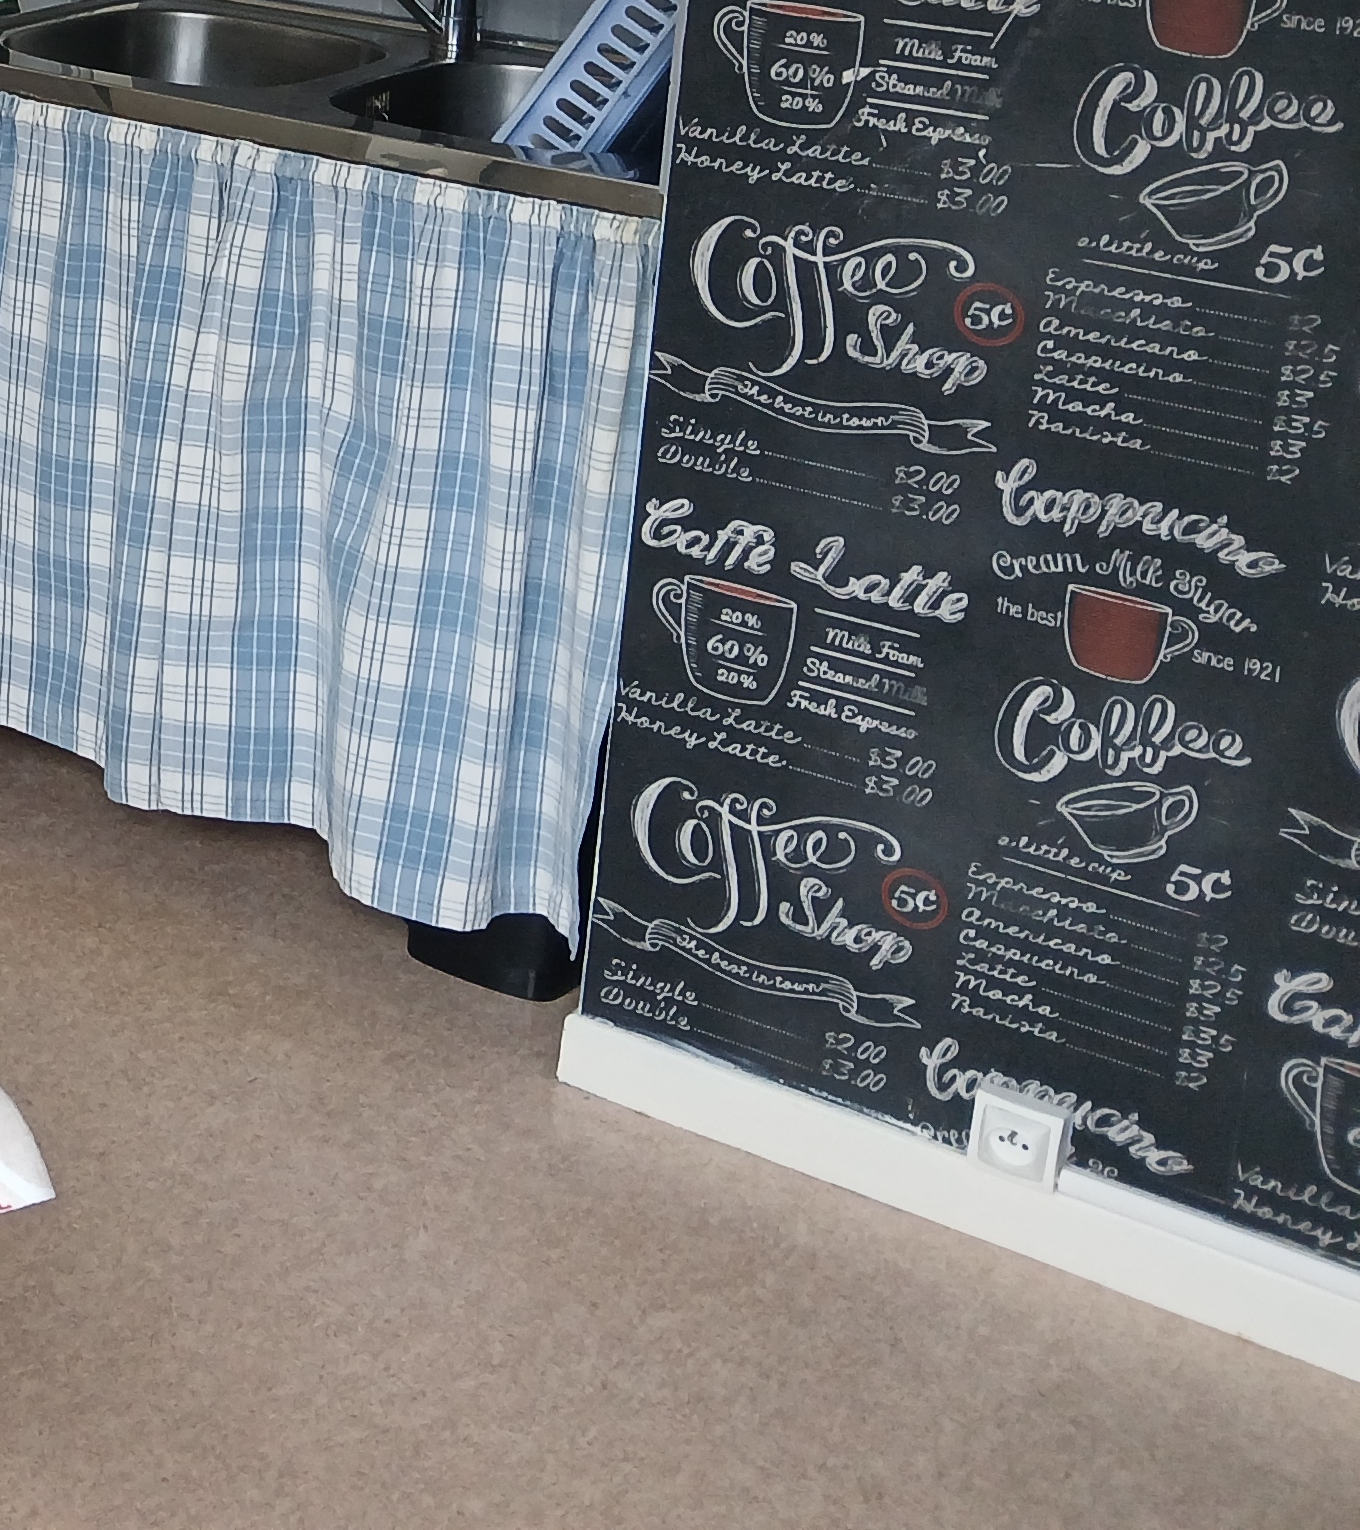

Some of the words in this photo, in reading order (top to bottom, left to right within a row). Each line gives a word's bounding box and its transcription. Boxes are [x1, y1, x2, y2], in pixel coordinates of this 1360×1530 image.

[1282, 10, 1327, 33] since
[947, 43, 998, 68] Foam
[679, 118, 785, 152] Vanilla
[789, 134, 871, 166] Latte
[853, 108, 907, 134] Fresh
[1074, 63, 1344, 175] Coffee
[675, 145, 775, 182] Honey
[779, 159, 854, 192] Latte
[1255, 243, 1324, 284] 5¢
[690, 215, 976, 377] Coffee
[1046, 268, 1192, 309] Espresso
[965, 301, 1014, 331] 5¢
[1039, 316, 1208, 361] Americano
[846, 305, 986, 395] Shop
[1036, 340, 1192, 383] Cappucino
[1034, 365, 1118, 395] Latte
[1032, 386, 1143, 425] Mocha
[661, 413, 762, 455] Single
[895, 466, 961, 494] $2.00
[1028, 411, 1151, 451] Barista
[654, 441, 753, 483] Double
[996, 459, 1286, 577] Cappucino
[790, 536, 969, 624] Latte
[991, 549, 1087, 581] Cream
[1095, 547, 1162, 587] Milk
[1171, 571, 1257, 635] Sugar
[996, 595, 1020, 618] the
[1024, 602, 1064, 628] best
[875, 636, 924, 668] Foam
[1192, 648, 1237, 672] since
[1244, 656, 1280, 682] 1921
[616, 701, 707, 748] Honey
[708, 730, 786, 770] Latte
[619, 678, 720, 721] Vanilla
[724, 705, 802, 747] Latte
[787, 690, 836, 719] Fresh
[840, 703, 918, 740] Espresso
[995, 676, 1253, 782] Coffee
[632, 776, 901, 933] Coffee
[891, 881, 937, 914] 5¢
[967, 862, 1106, 915] Espresso
[1165, 863, 1232, 902] 5¢
[780, 876, 913, 969] Shop
[960, 906, 1119, 966] Americano
[956, 951, 1036, 987] Latte
[958, 927, 1107, 987] Cappucino
[774, 978, 829, 995] town
[954, 971, 1060, 1020] Mocha
[602, 961, 699, 1008] Single
[826, 1030, 888, 1063] $2.00
[949, 993, 1066, 1045] Barista
[599, 986, 691, 1031] Double
[821, 1060, 887, 1093] $3.00
